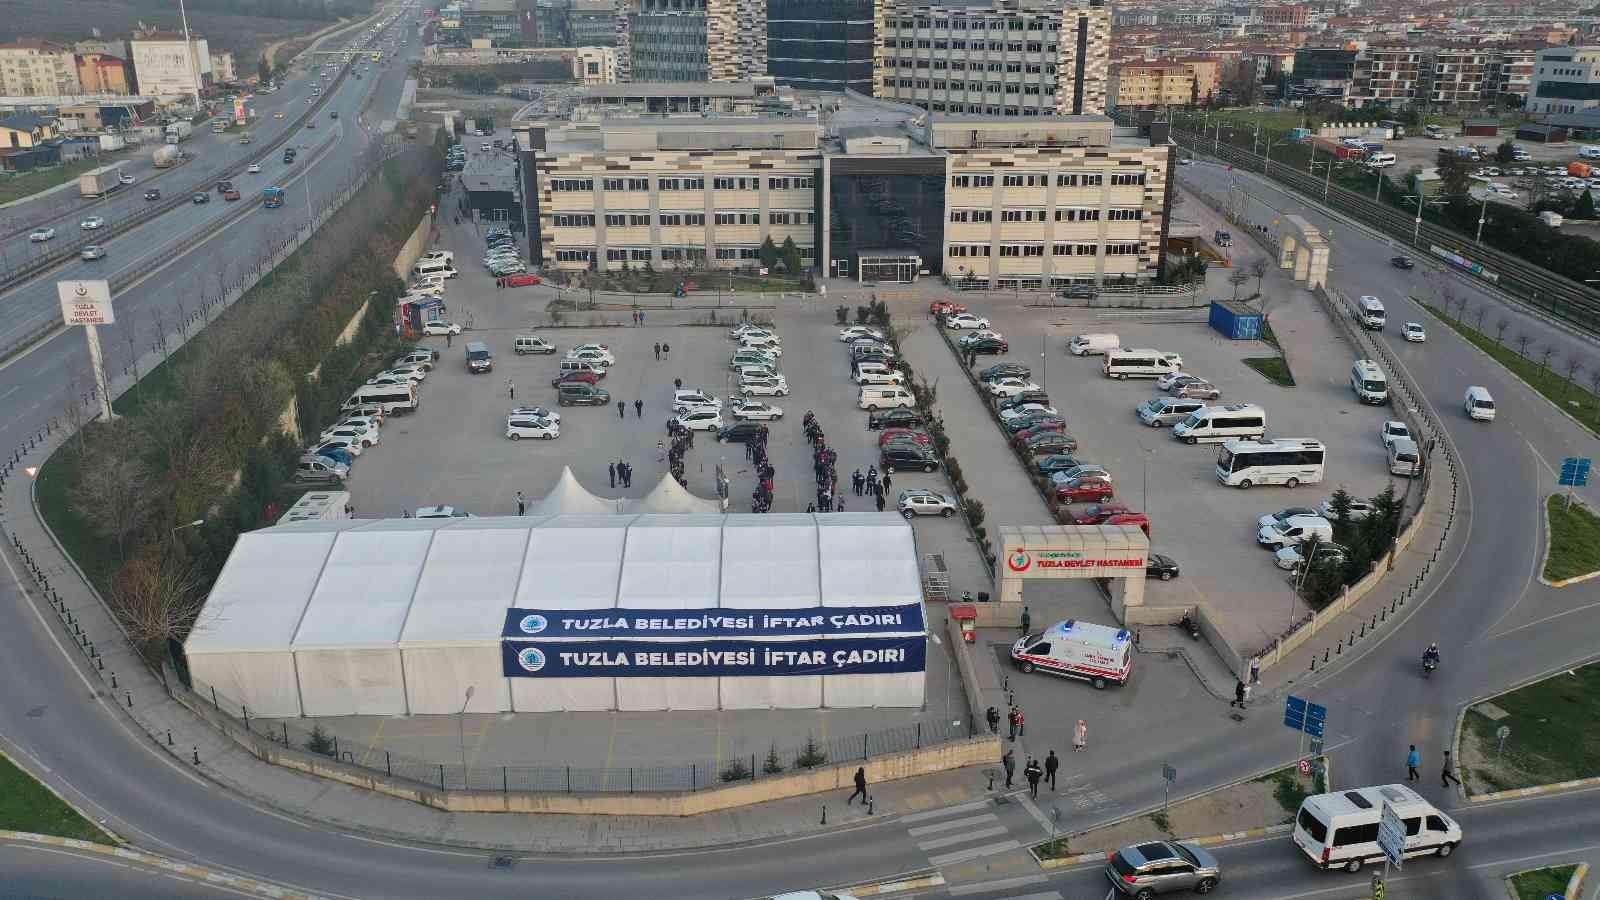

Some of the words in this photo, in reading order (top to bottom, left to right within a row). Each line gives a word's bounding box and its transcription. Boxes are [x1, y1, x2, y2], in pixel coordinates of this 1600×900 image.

[1037, 560, 1063, 568] TUZLA
[561, 618, 630, 630] TUZLA
[634, 615, 754, 630] BELEDİYESİ
[763, 614, 825, 629] İFTAR
[830, 614, 902, 629] ÇADIRI
[559, 652, 630, 666] TUZLA
[634, 648, 755, 666] BELEDİYESİ
[764, 648, 826, 666] İFTAR
[832, 648, 905, 668] ÇADIRI
